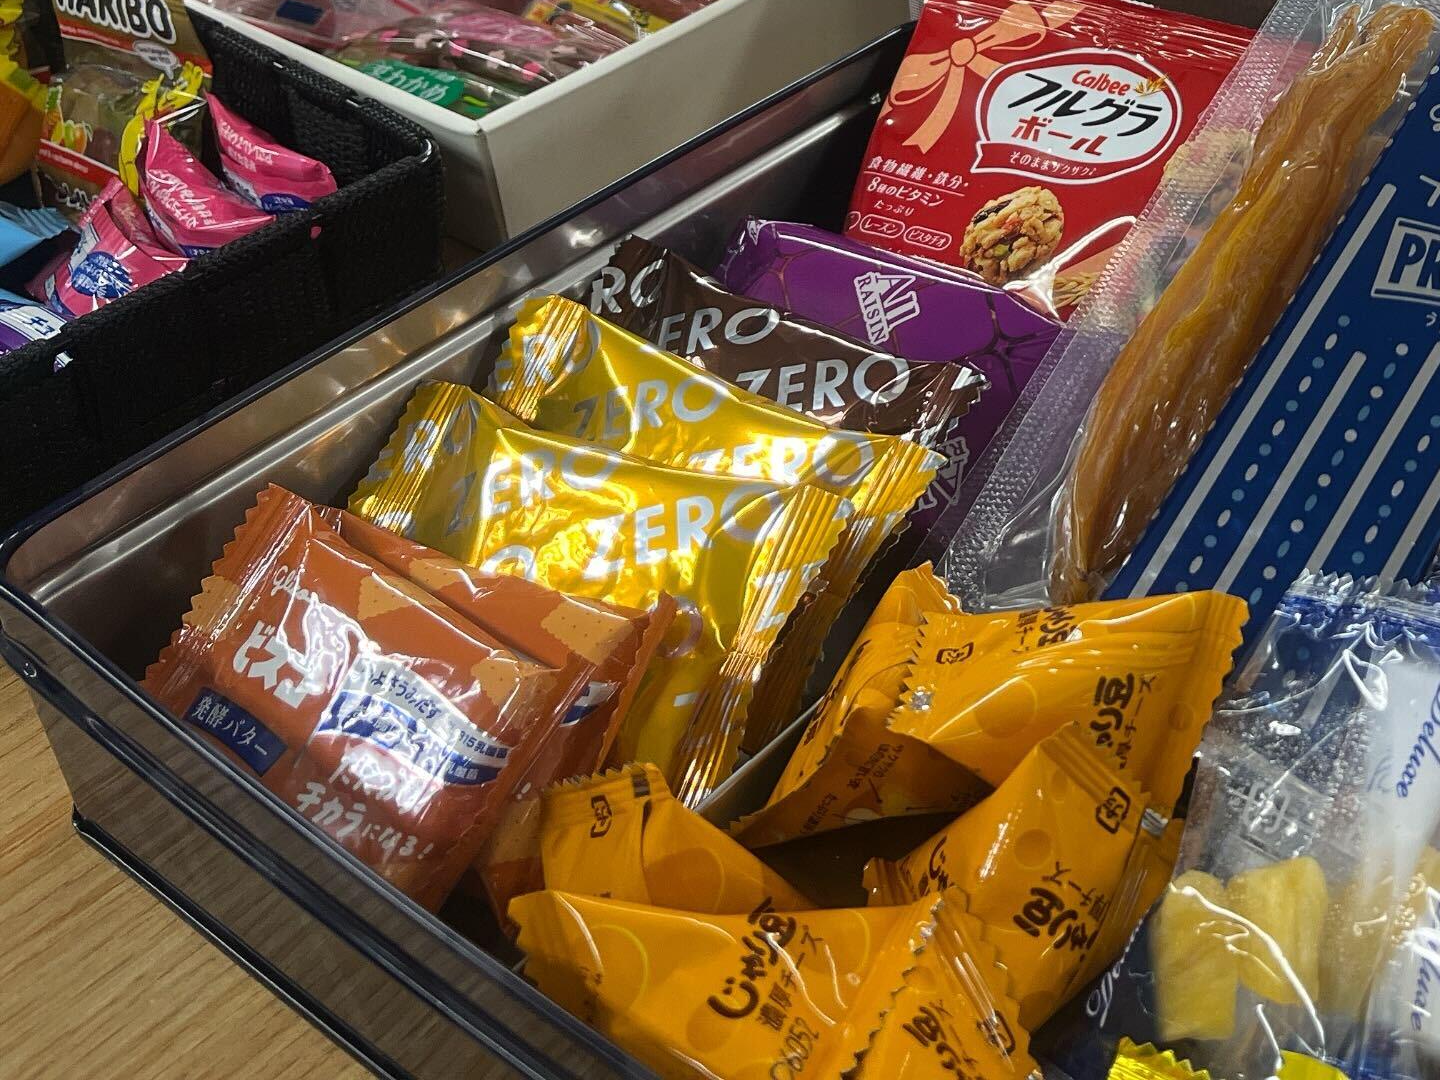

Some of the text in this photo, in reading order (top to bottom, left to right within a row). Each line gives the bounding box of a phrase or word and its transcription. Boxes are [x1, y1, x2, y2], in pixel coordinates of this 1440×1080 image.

[1007, 72, 1163, 137] フルグラ
[1071, 68, 1132, 97] Calbee
[1011, 115, 1109, 157] ボール
[863, 218, 899, 234] レーズン
[657, 307, 780, 357] ERO
[857, 275, 889, 344] RAISIN
[572, 375, 729, 442] ZERO
[735, 353, 910, 412] ZERO
[584, 484, 782, 582] ZERO
[191, 694, 268, 757] 発酵バター
